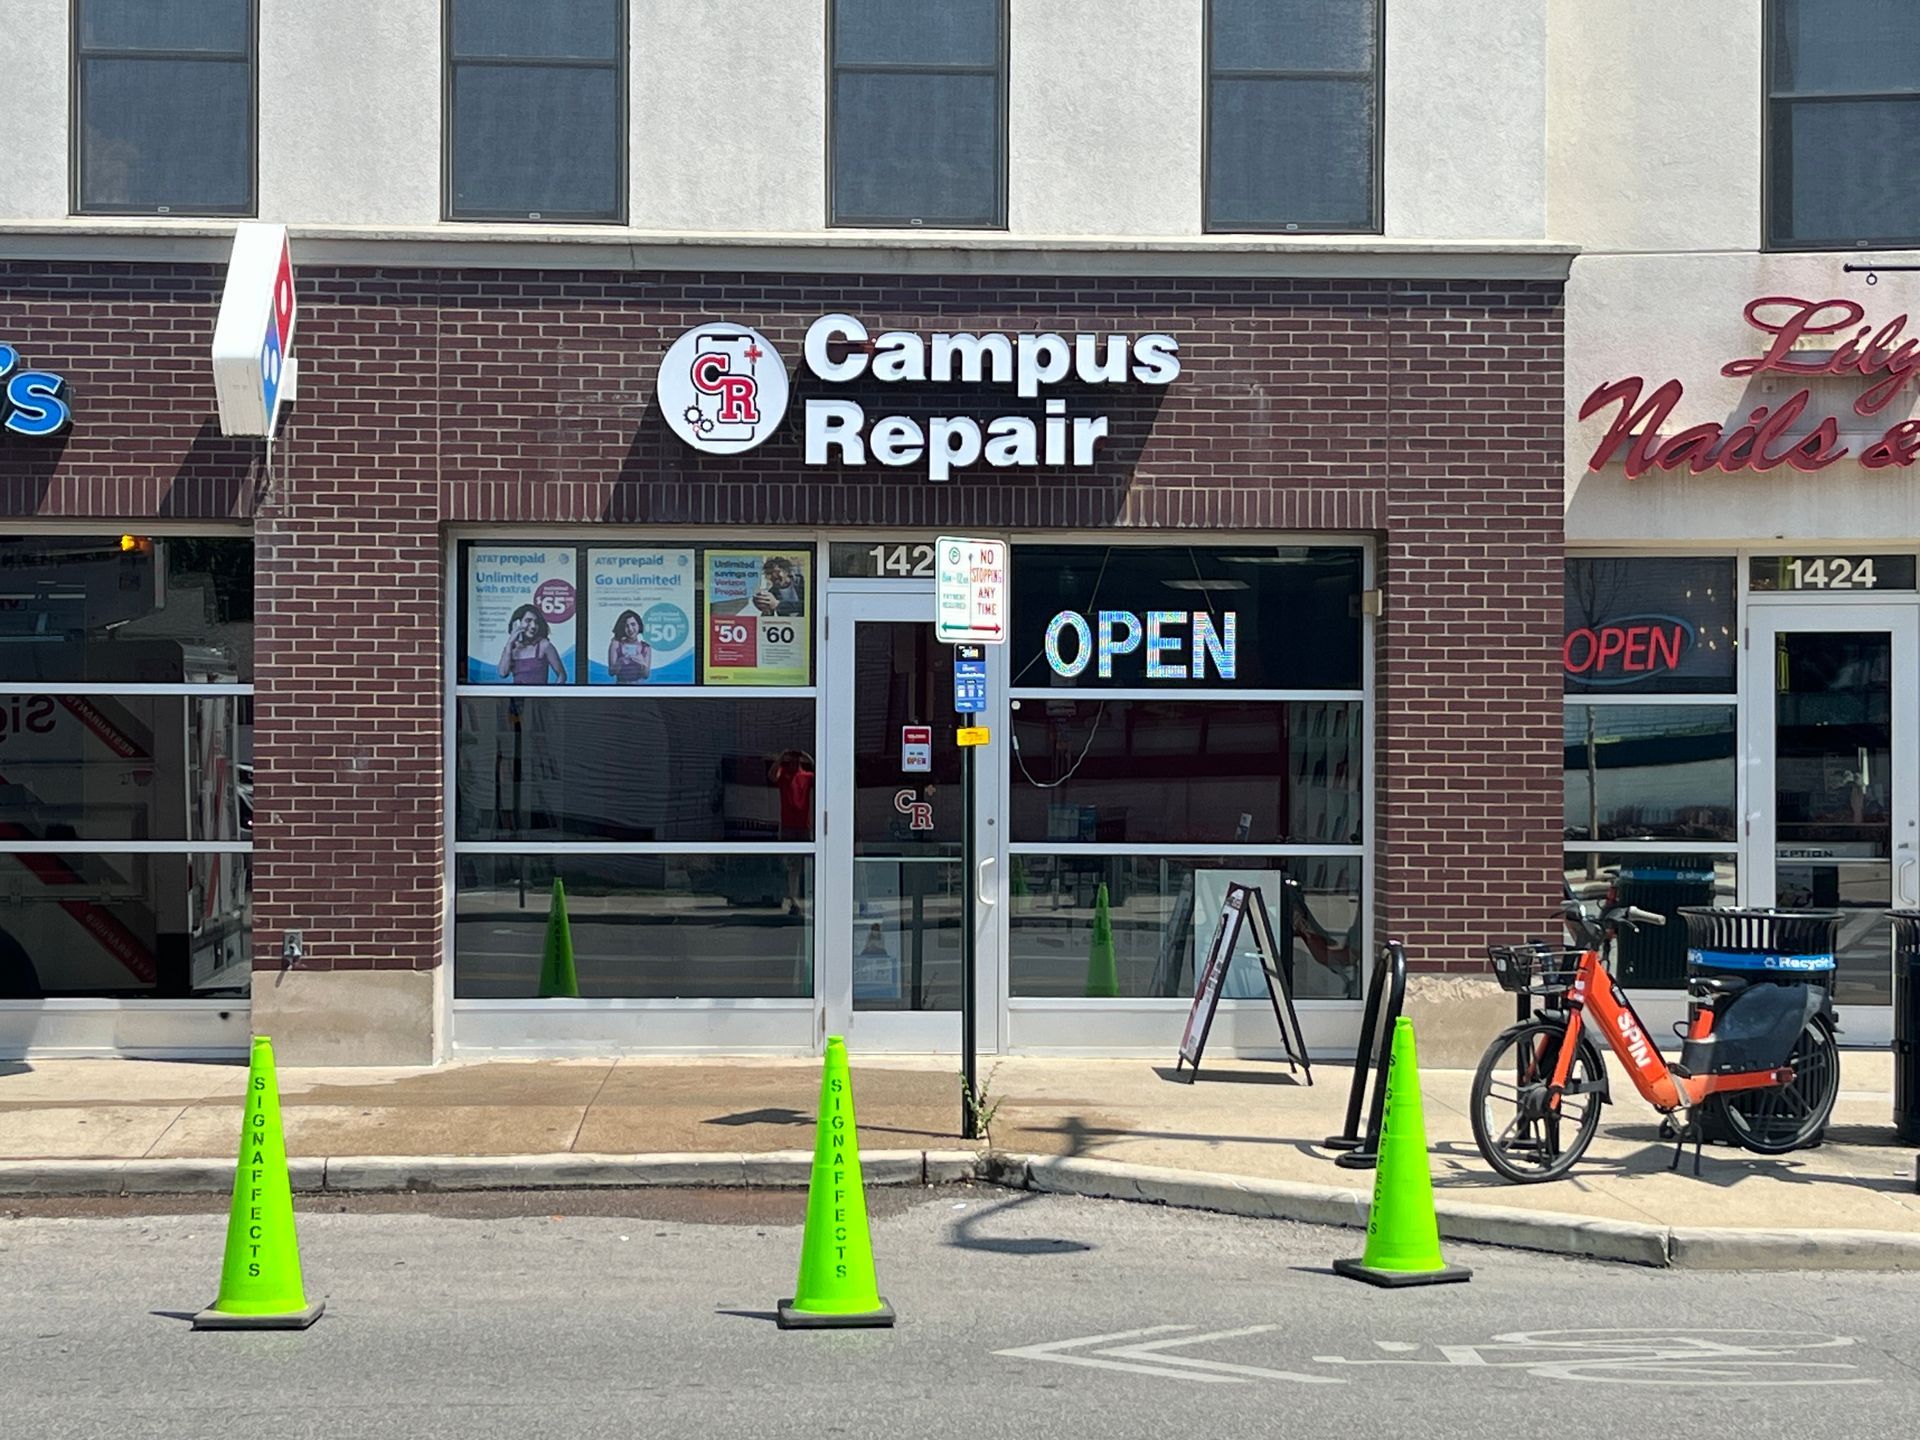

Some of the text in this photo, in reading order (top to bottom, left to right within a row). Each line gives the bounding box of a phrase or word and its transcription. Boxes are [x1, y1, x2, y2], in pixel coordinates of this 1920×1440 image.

[804, 312, 1182, 397] Campus
[690, 351, 759, 424] CR
[1578, 376, 1849, 480] Nails
[804, 399, 1109, 482] Repair
[500, 553, 545, 566] prepaid
[595, 555, 664, 568] AT&T prepaid
[714, 560, 756, 569] Unlimited
[869, 545, 935, 576] 142
[980, 549, 994, 565] NO
[476, 572, 539, 584] Unlimited
[595, 573, 681, 586] Go unlimited!
[971, 567, 1004, 584] STOPPING
[1787, 558, 1877, 589] 1424
[476, 584, 531, 594] with extras
[714, 579, 746, 587] Verizon
[714, 587, 747, 596] Prepaid
[978, 588, 996, 599] ANY
[977, 603, 997, 616] TIME
[1045, 610, 1236, 679] OPEN
[1563, 626, 1683, 673] OPEN
[1616, 1009, 1653, 1069] SPIN
[248, 1076, 266, 1277] SIGNAFFECTS
[831, 1078, 847, 1278] SIGNAFFECTS
